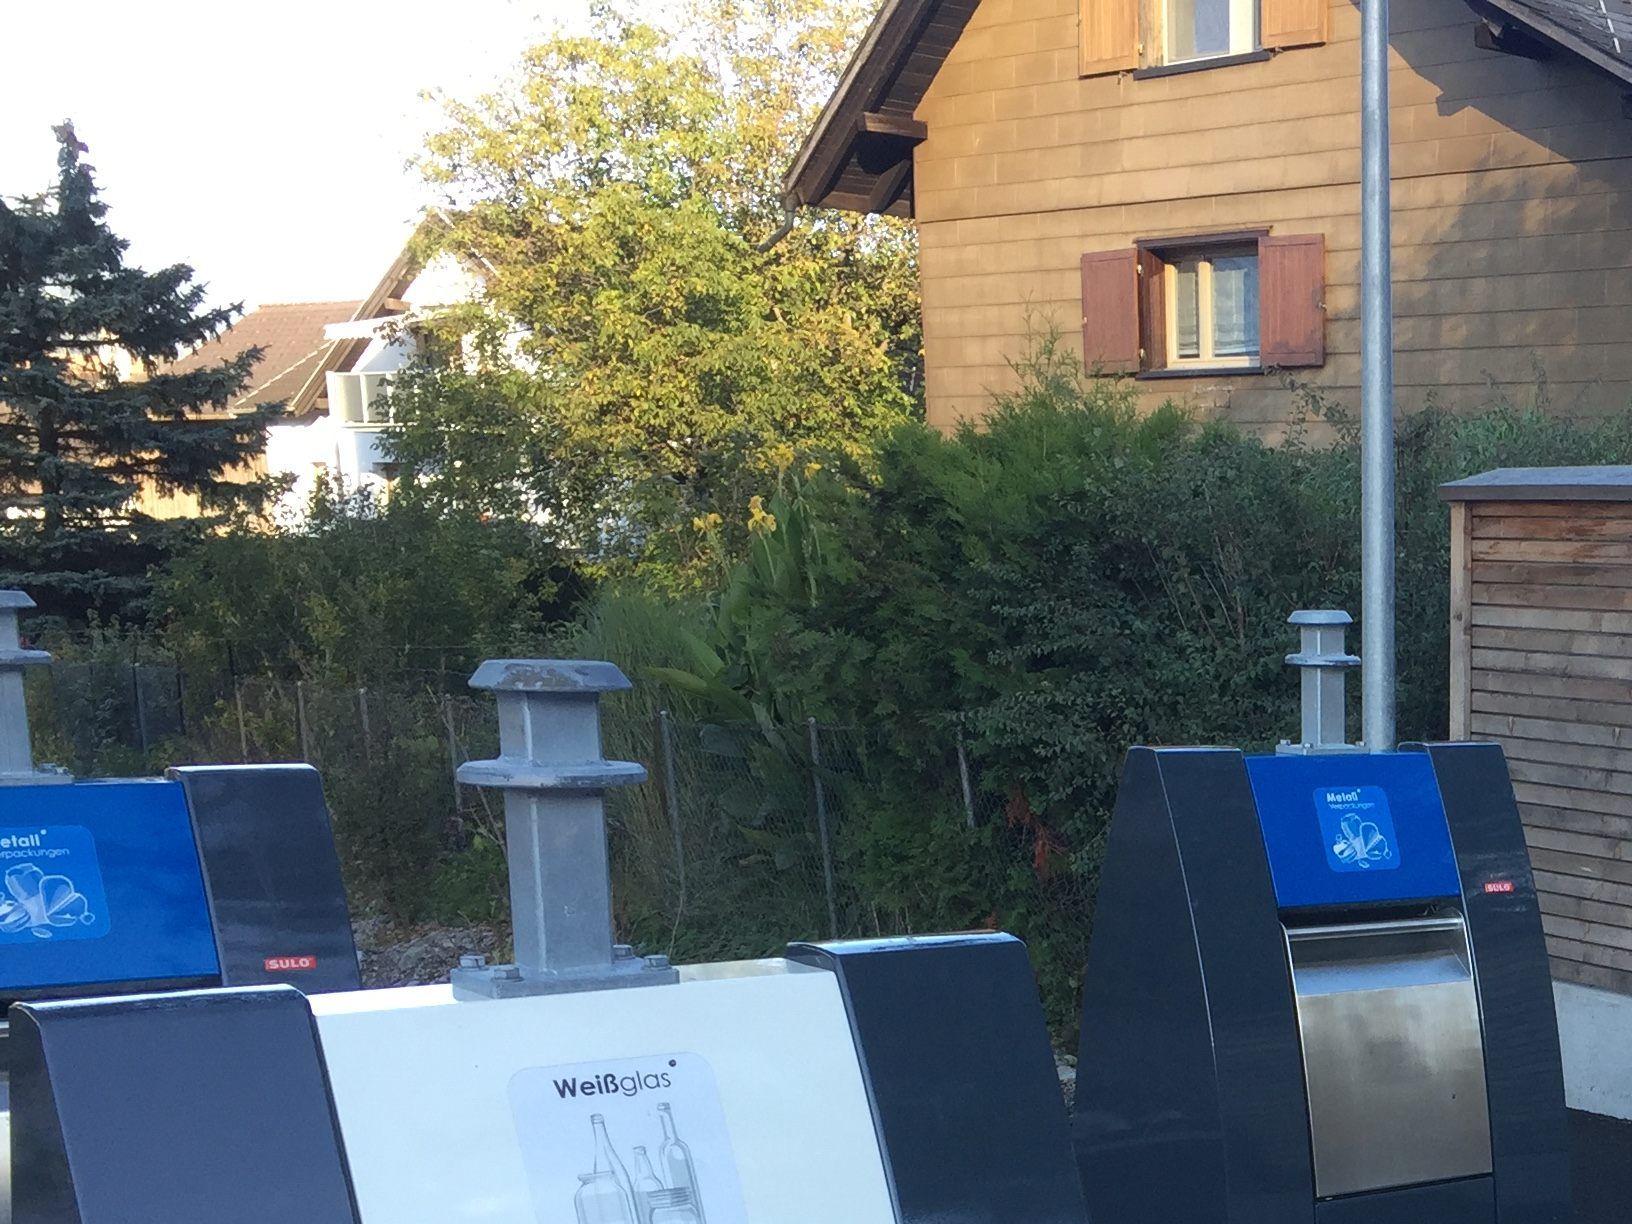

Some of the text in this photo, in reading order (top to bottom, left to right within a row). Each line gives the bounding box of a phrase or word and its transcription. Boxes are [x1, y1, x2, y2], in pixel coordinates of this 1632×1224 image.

[0, 833, 41, 849] etall
[0, 848, 70, 860] rpackungen
[268, 958, 311, 970] SULO
[552, 1070, 672, 1099] Weißglas
